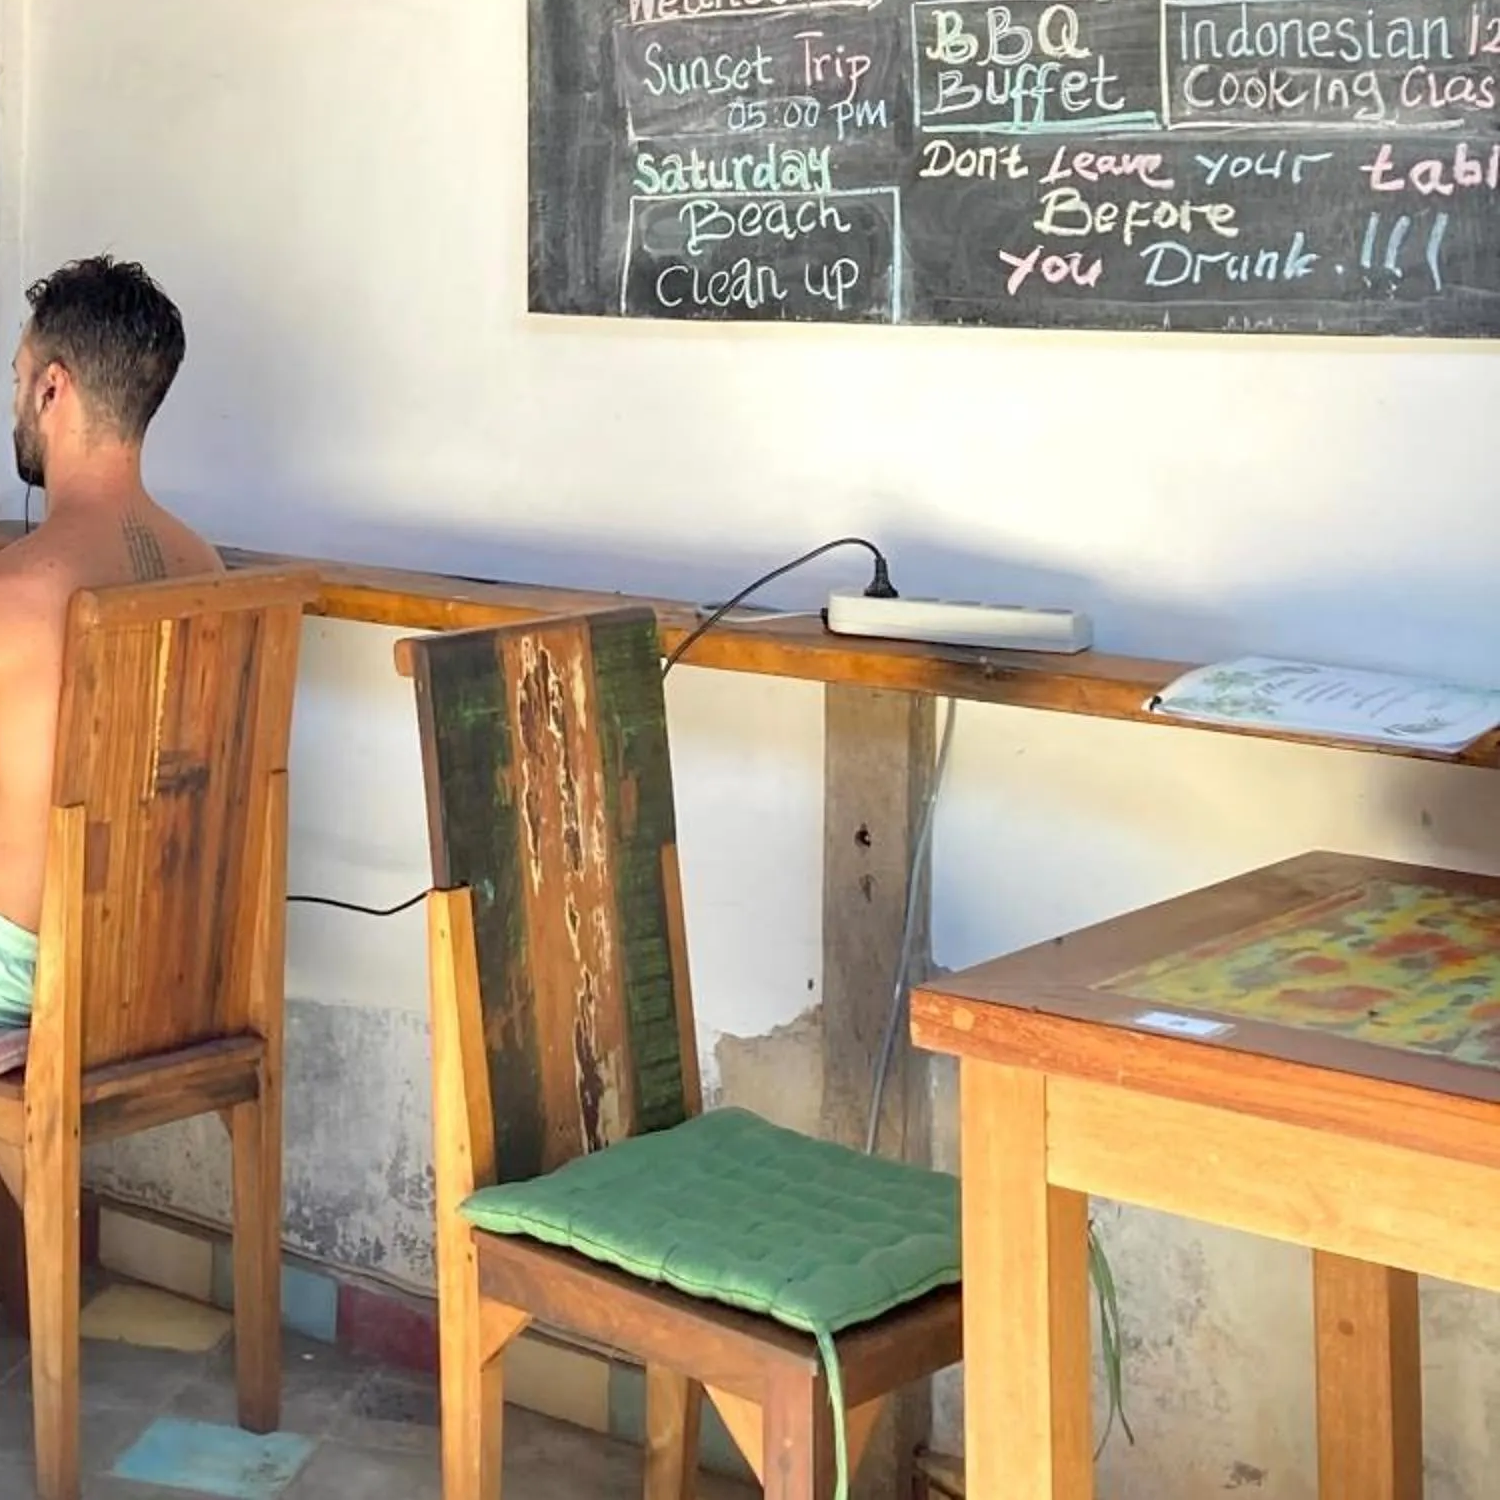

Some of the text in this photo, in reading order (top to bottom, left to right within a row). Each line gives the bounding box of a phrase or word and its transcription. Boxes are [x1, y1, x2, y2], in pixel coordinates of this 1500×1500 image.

[925, 4, 1093, 66] BBQ
[1181, 3, 1454, 61] Indonesian
[643, 31, 872, 100] Sunset Trip
[921, 54, 1126, 131] Buffet
[727, 100, 820, 131] 05:00
[919, 139, 1029, 180] Don't
[1039, 145, 1175, 189] Leave
[1195, 150, 1333, 186] your
[679, 198, 851, 255] Beach
[656, 258, 786, 308] Clean
